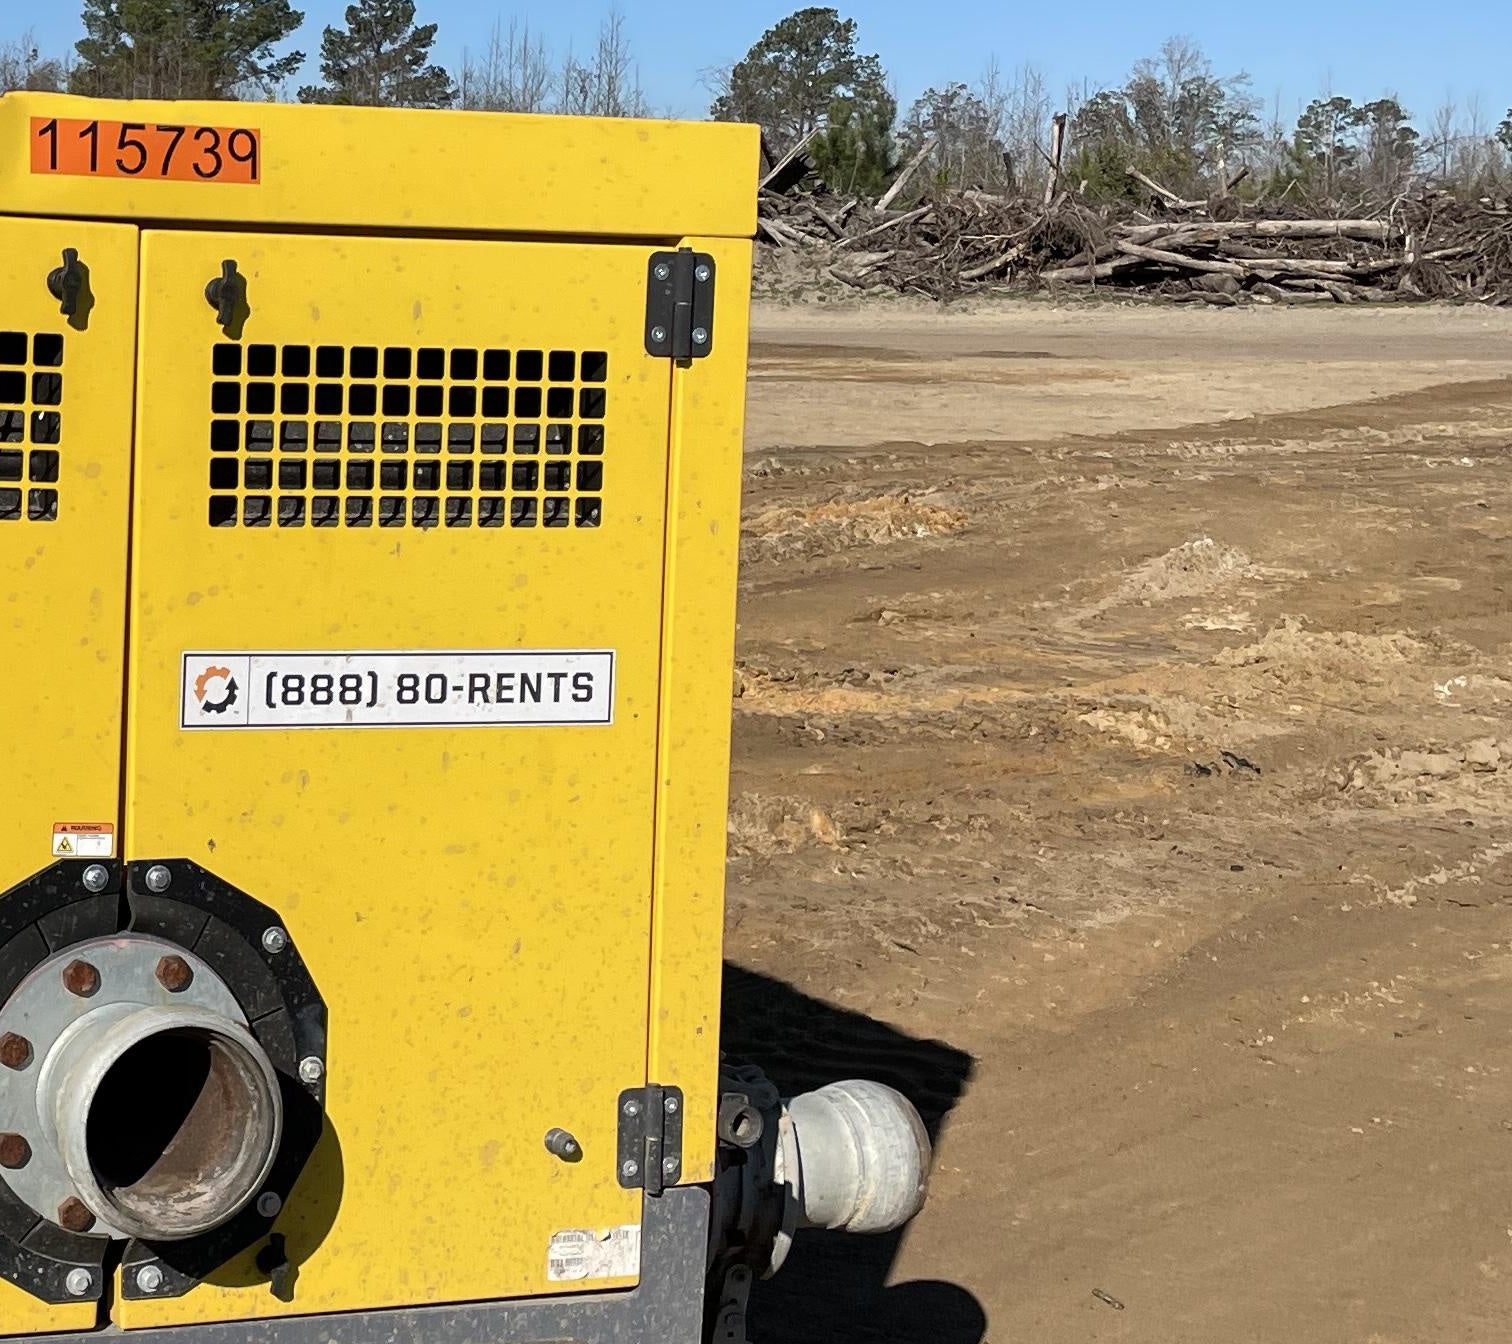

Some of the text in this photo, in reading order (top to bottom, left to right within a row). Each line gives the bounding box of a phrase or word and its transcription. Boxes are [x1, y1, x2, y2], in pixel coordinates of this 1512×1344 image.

[38, 118, 257, 180] 115739
[265, 671, 594, 708] (888) 80-RENTS
